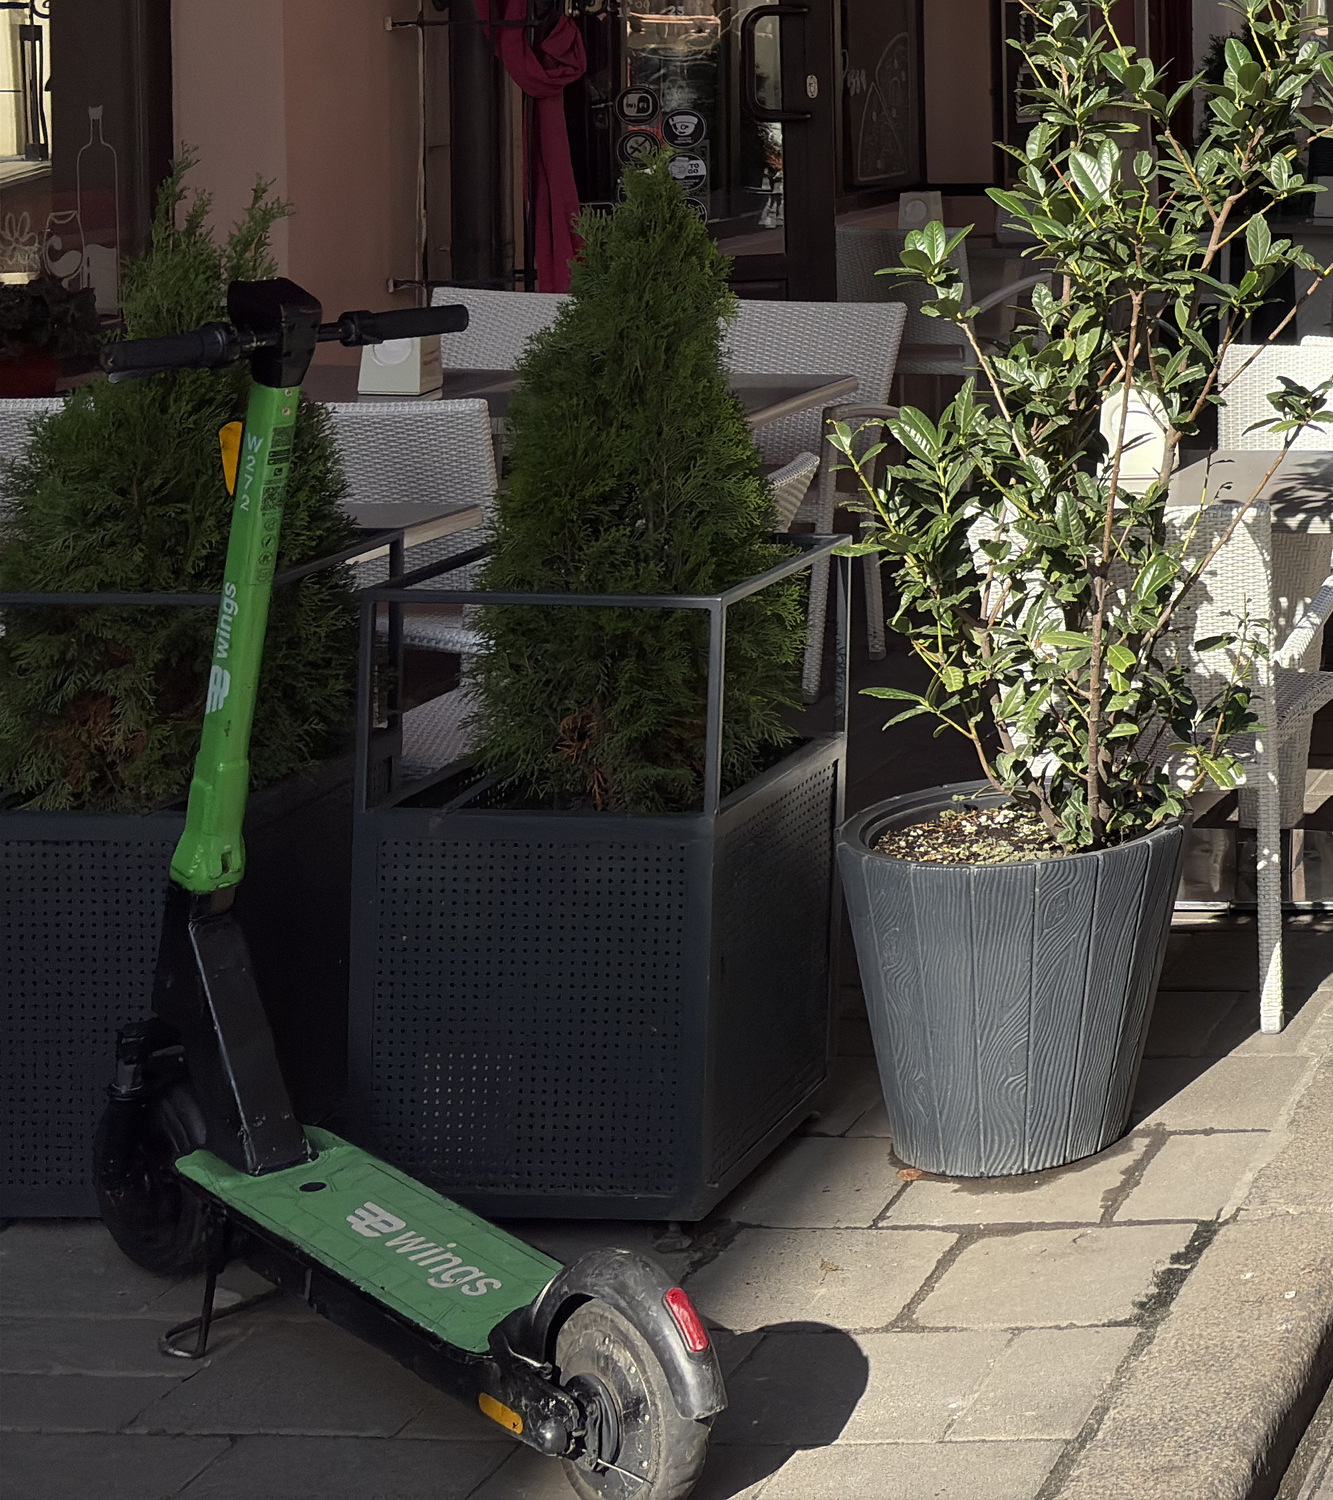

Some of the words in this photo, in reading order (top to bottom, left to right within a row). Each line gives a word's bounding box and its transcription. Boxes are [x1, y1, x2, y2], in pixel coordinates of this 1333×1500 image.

[239, 432, 263, 512] W272
[216, 582, 239, 659] wings
[385, 1230, 502, 1296] wings
